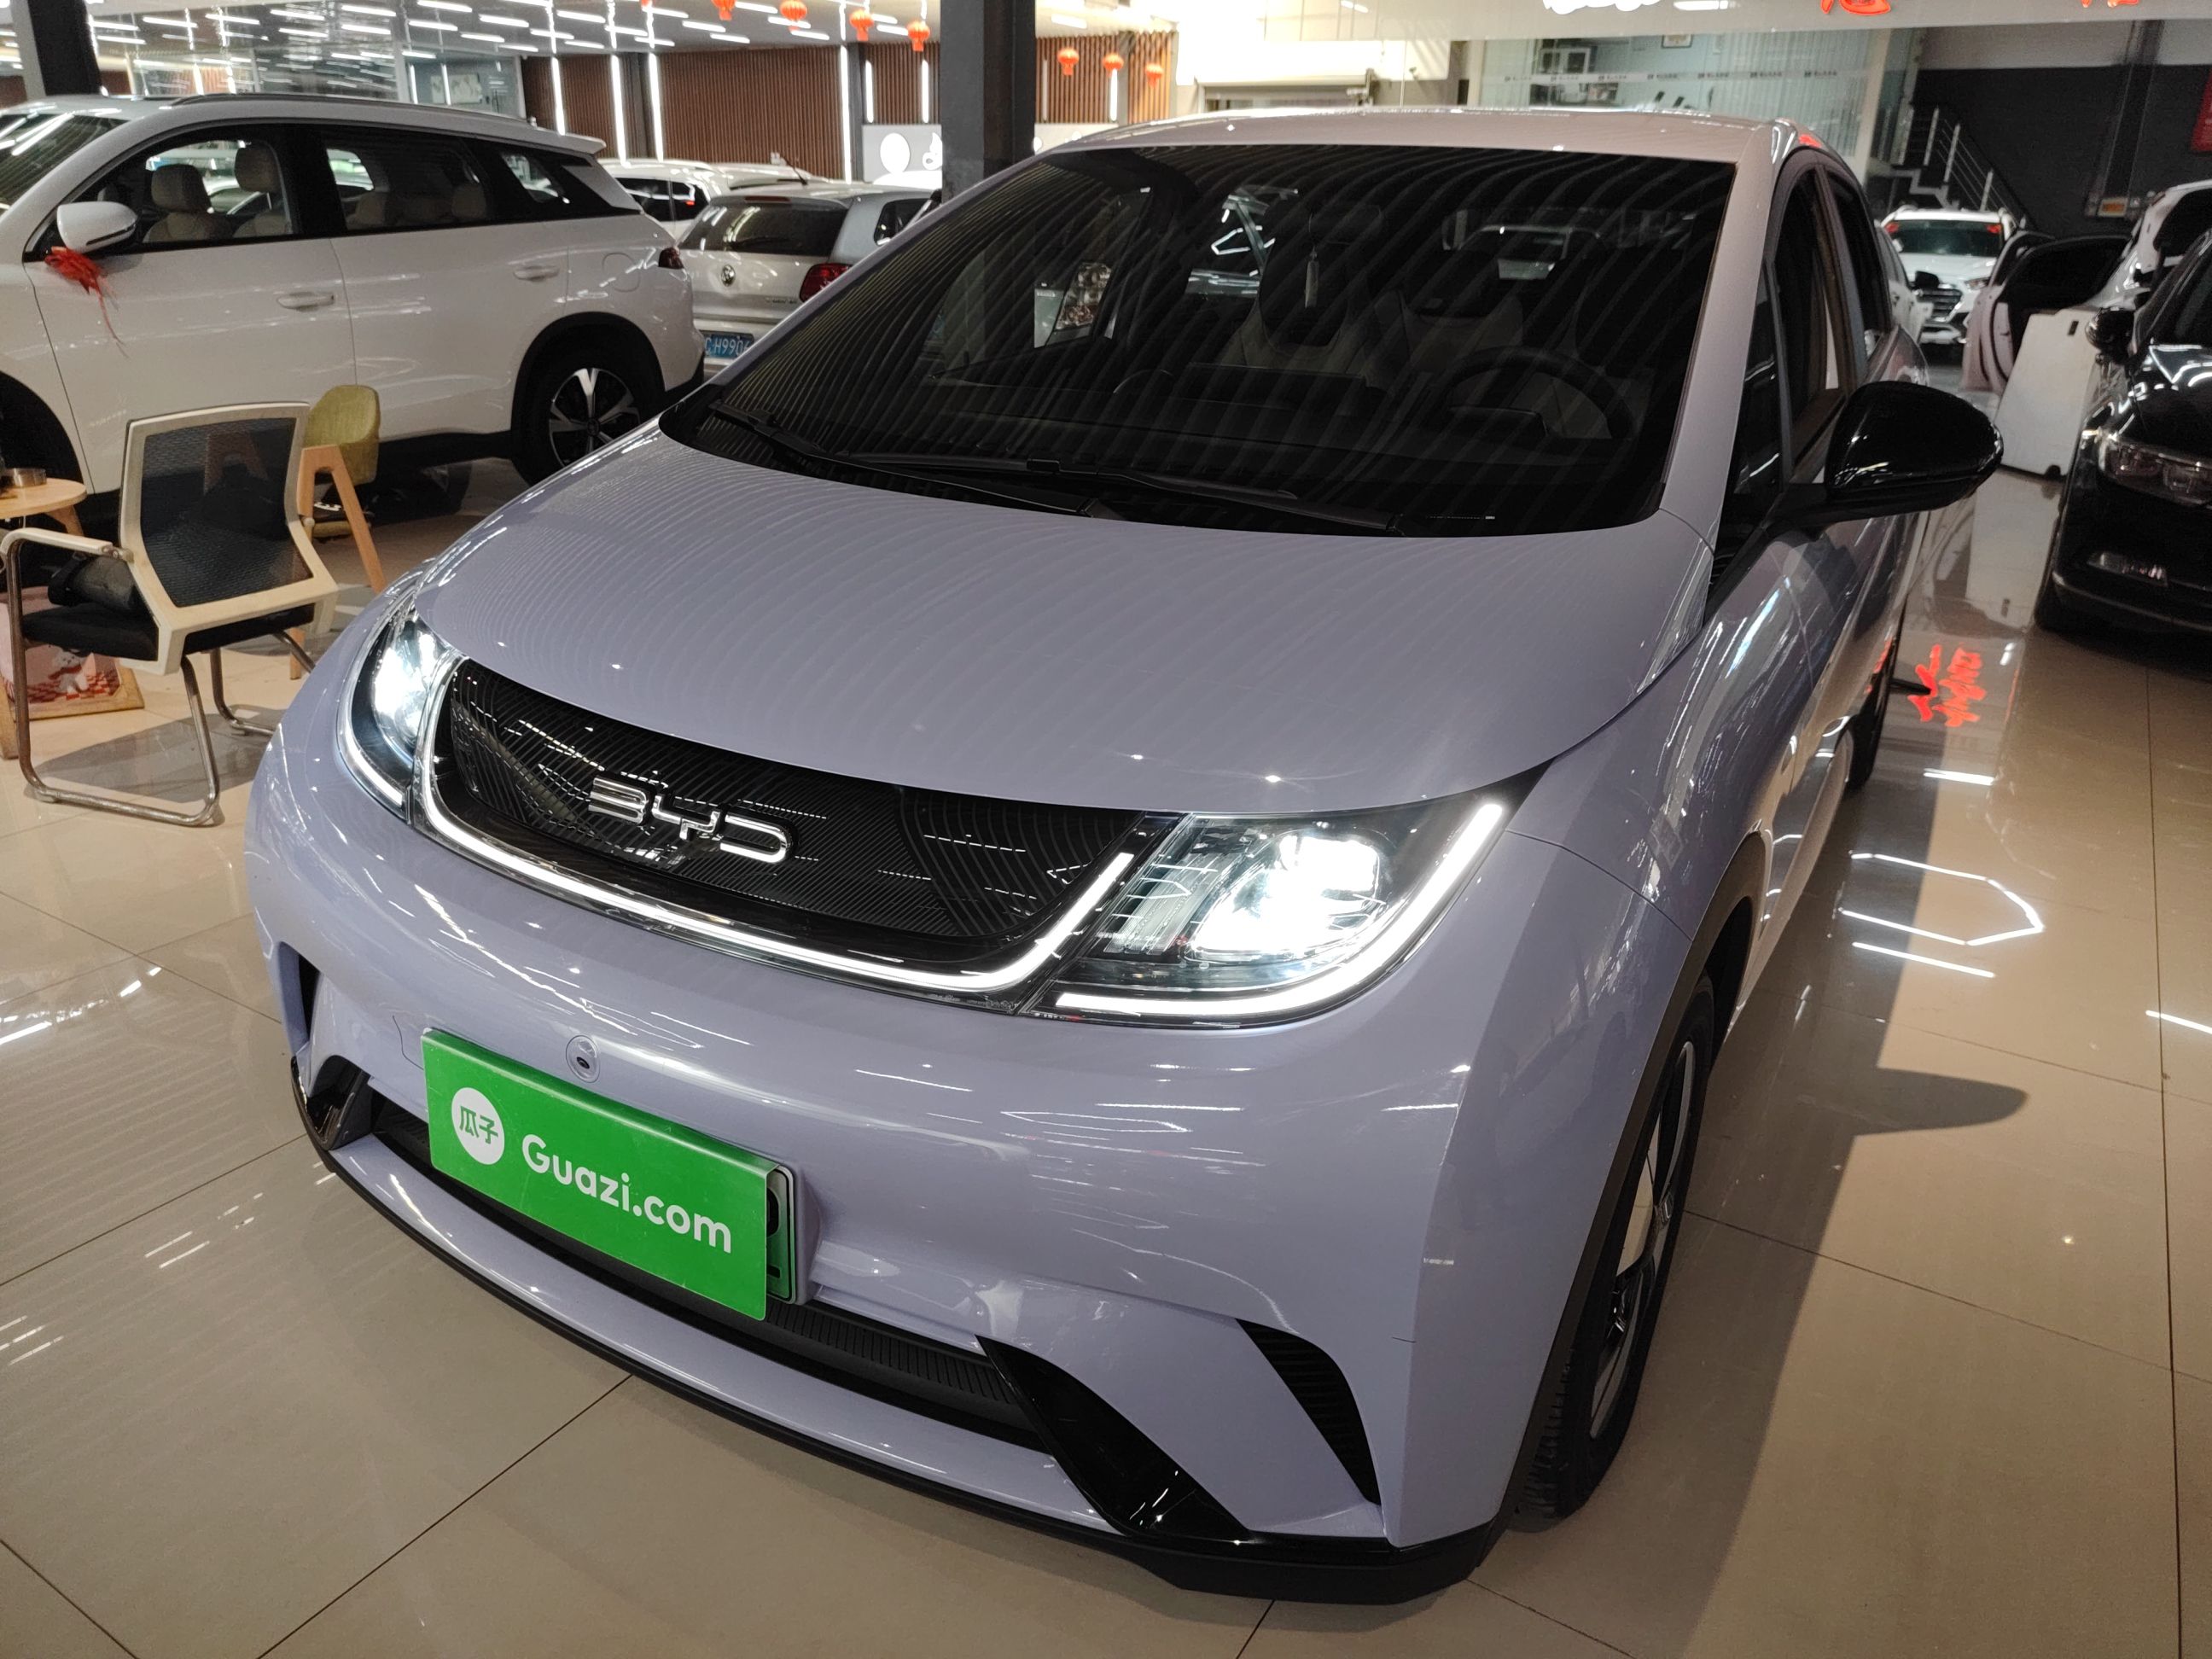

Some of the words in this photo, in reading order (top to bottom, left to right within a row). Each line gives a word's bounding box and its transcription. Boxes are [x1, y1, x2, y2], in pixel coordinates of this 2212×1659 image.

[589, 777, 788, 864] BYD
[459, 1105, 498, 1144] 瓜子
[522, 1134, 731, 1254] Guazi.com
